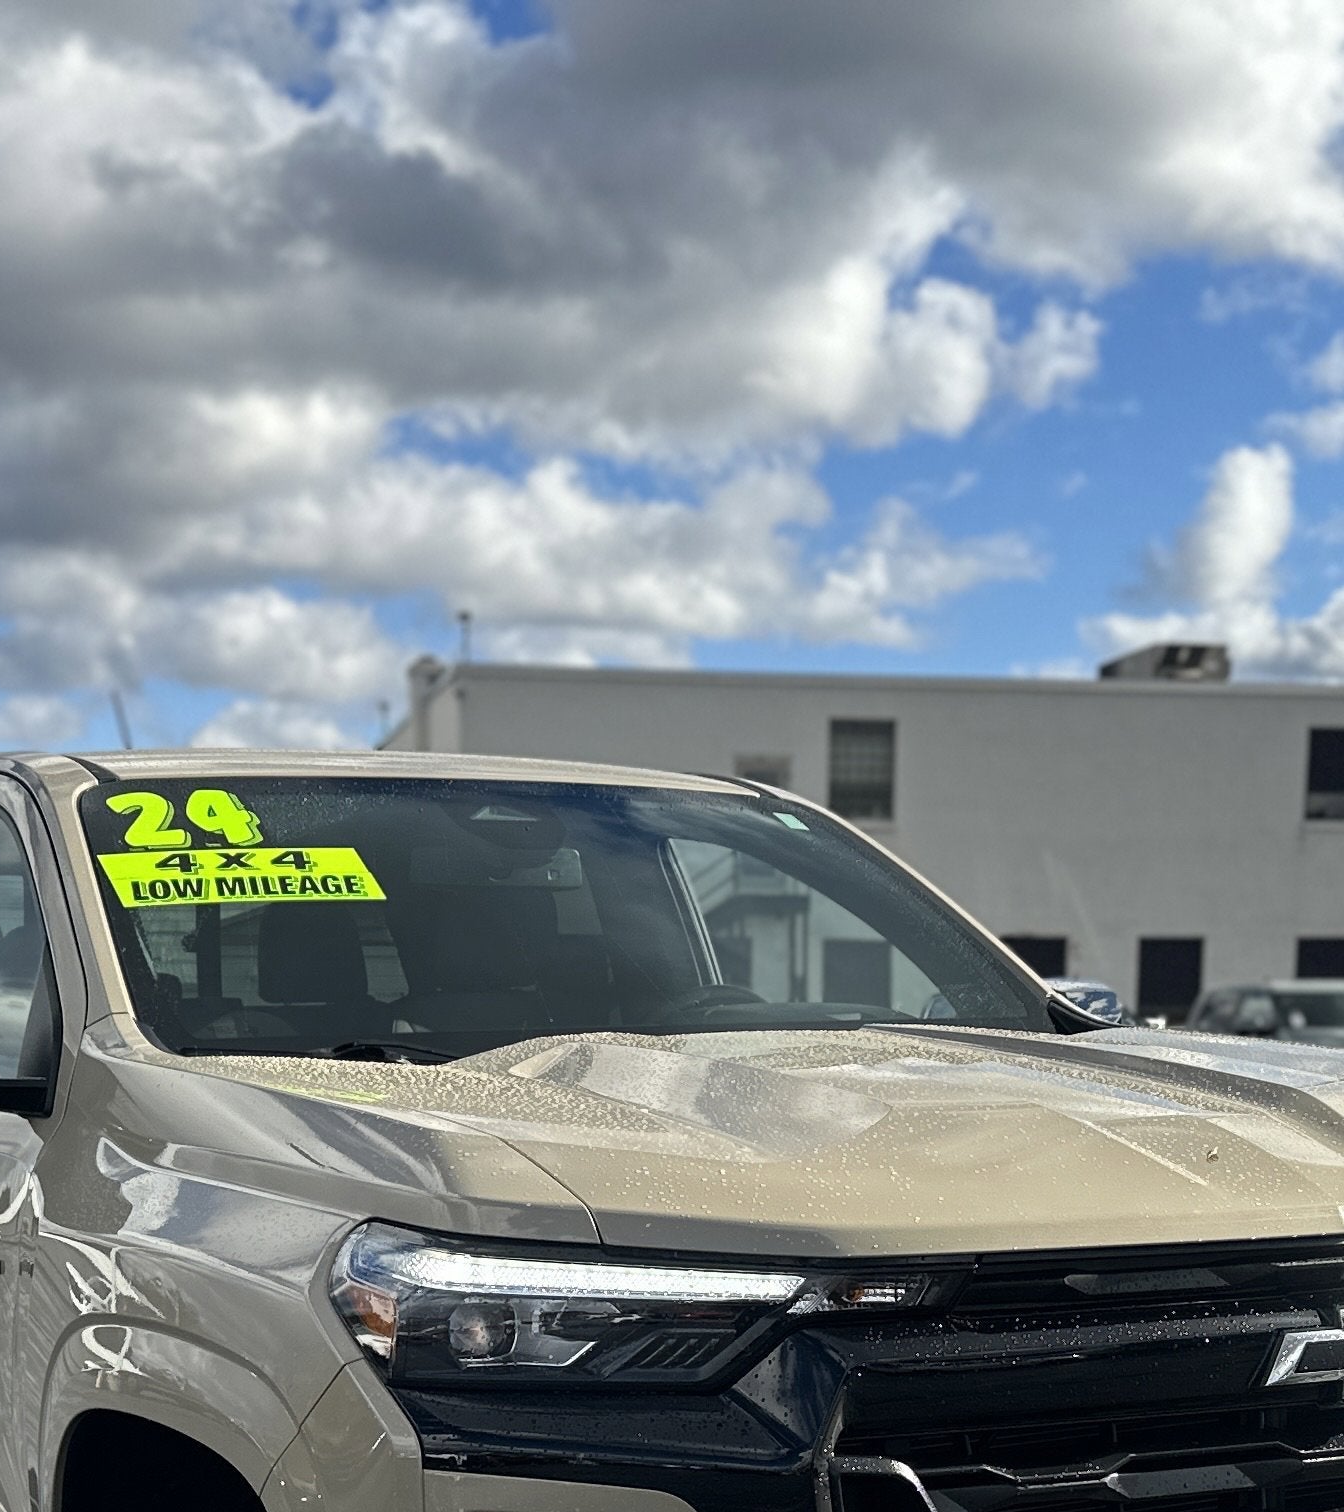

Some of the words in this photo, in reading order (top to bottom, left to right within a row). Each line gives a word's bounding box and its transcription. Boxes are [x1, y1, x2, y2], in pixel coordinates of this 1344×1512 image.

[106, 788, 263, 849] 24
[131, 877, 209, 901] LOW
[215, 873, 369, 898] MILEAGE
